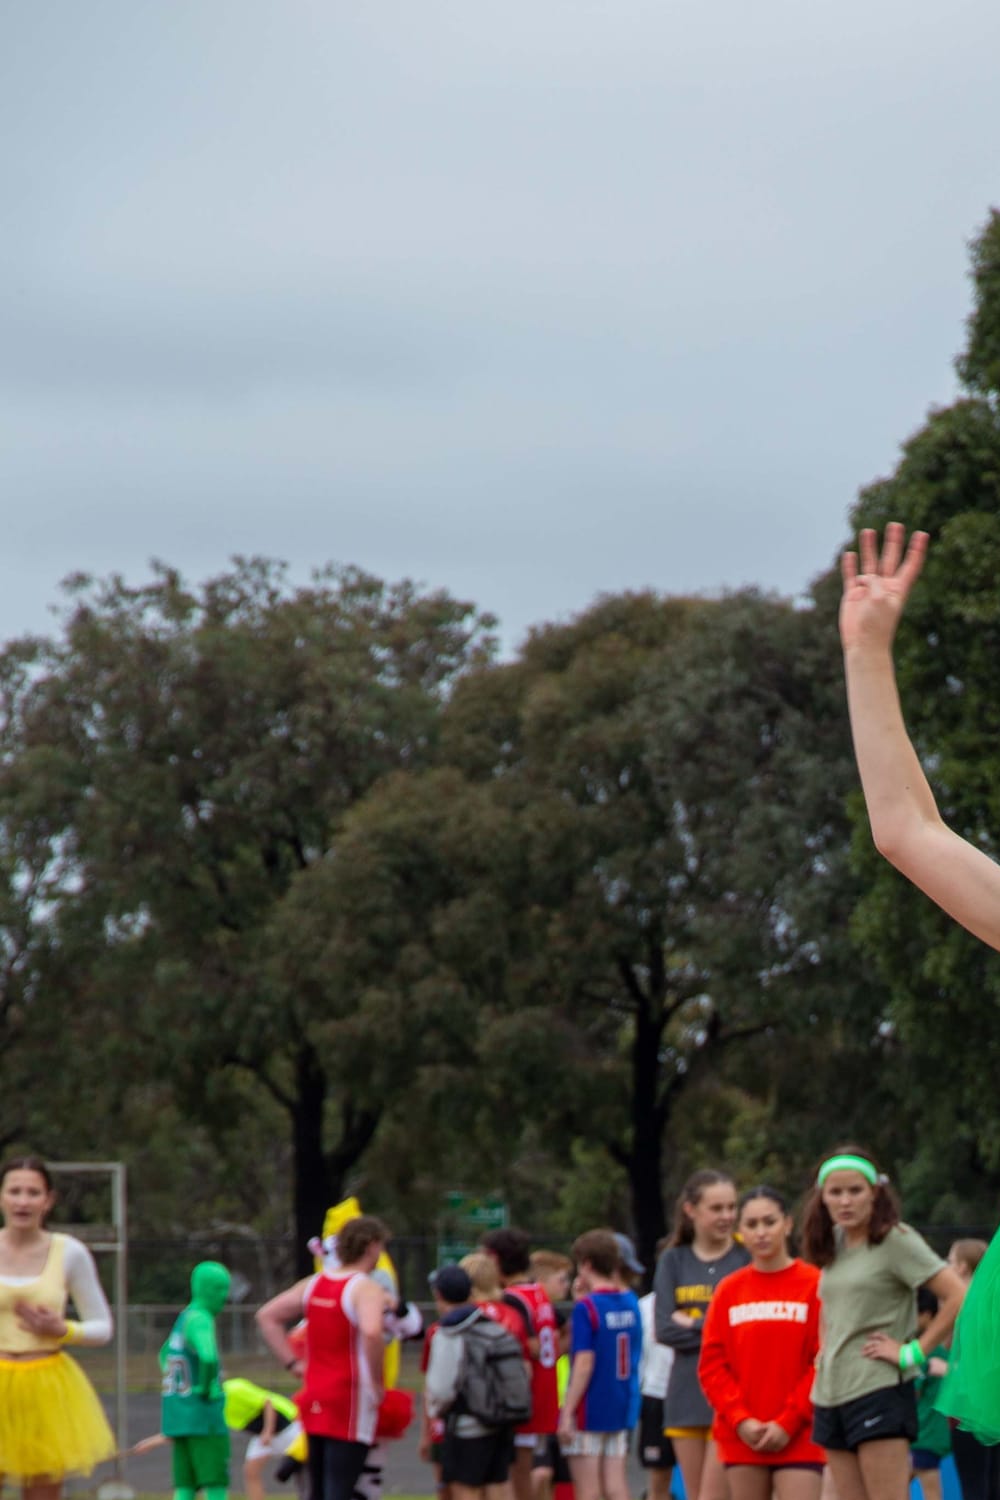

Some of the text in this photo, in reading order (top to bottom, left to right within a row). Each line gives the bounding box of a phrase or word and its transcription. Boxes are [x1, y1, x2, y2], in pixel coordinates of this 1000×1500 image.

[728, 1301, 808, 1327] BROOKLYN
[539, 1325, 555, 1368] 8
[616, 1332, 631, 1381] 1
